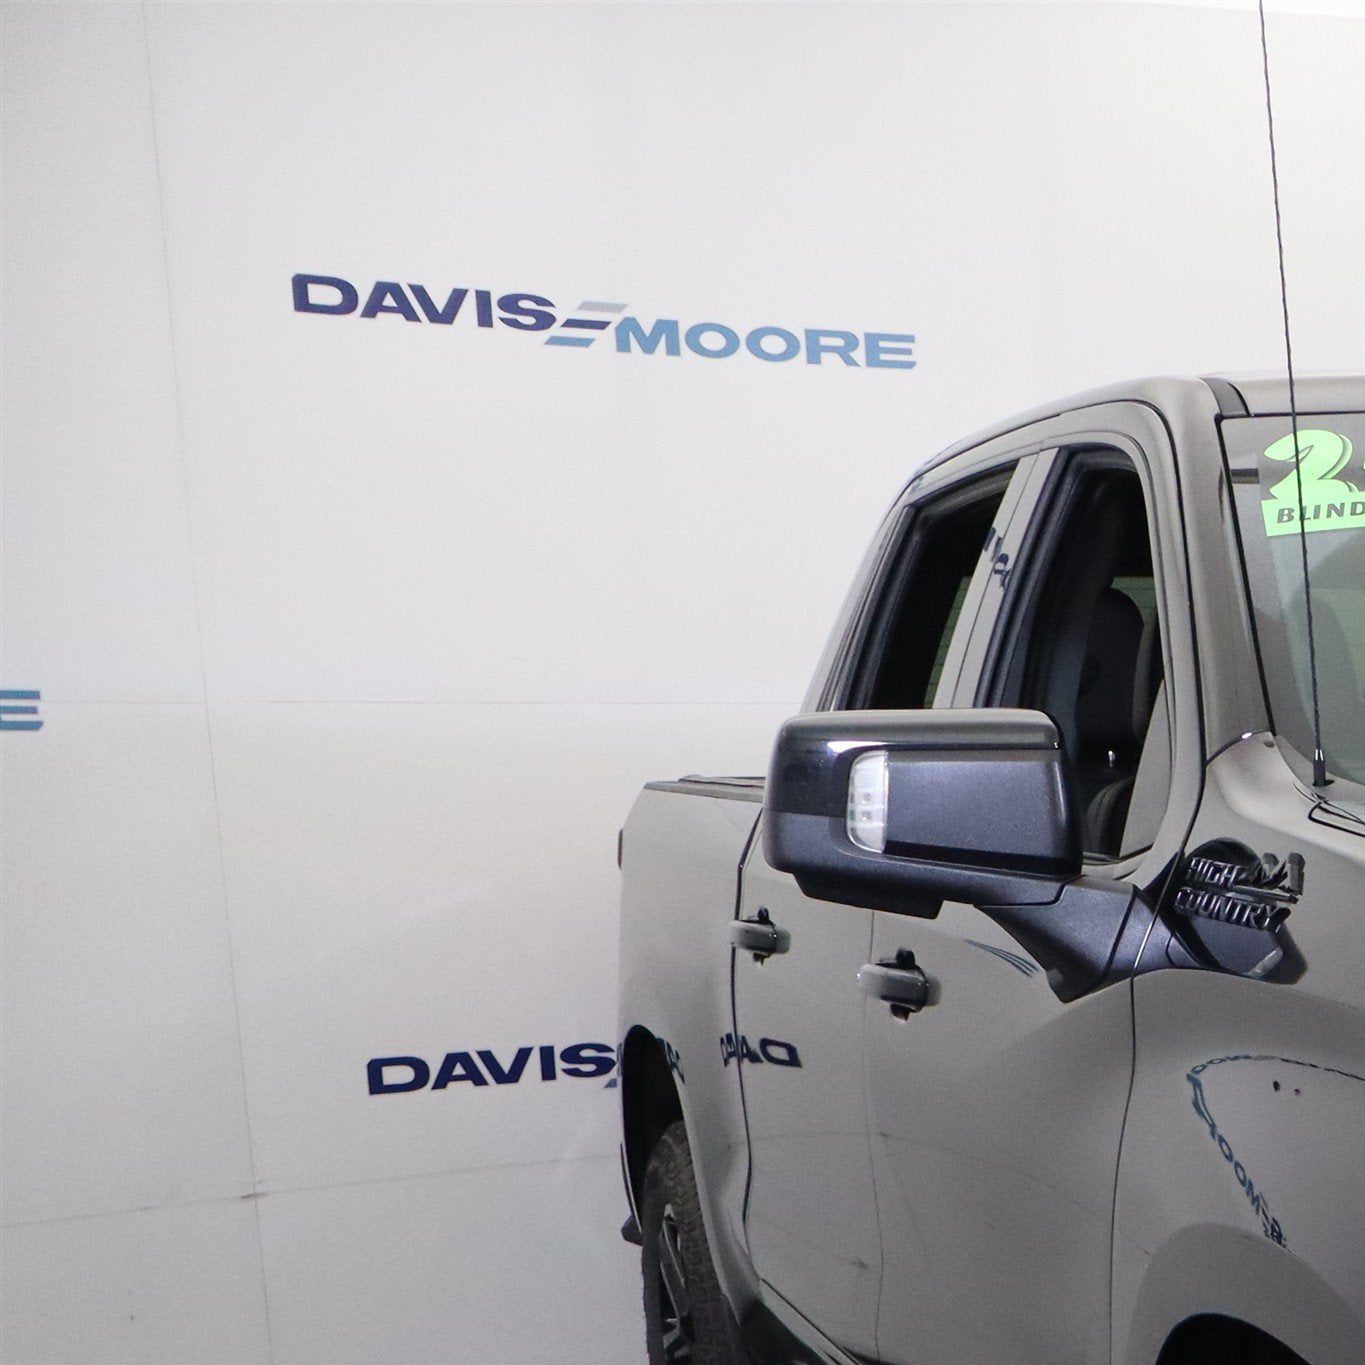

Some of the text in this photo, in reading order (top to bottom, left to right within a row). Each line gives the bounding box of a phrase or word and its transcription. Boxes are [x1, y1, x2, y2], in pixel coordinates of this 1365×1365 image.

[291, 272, 917, 370] DAVIS MOORE
[367, 1041, 616, 1095] DAVIS
